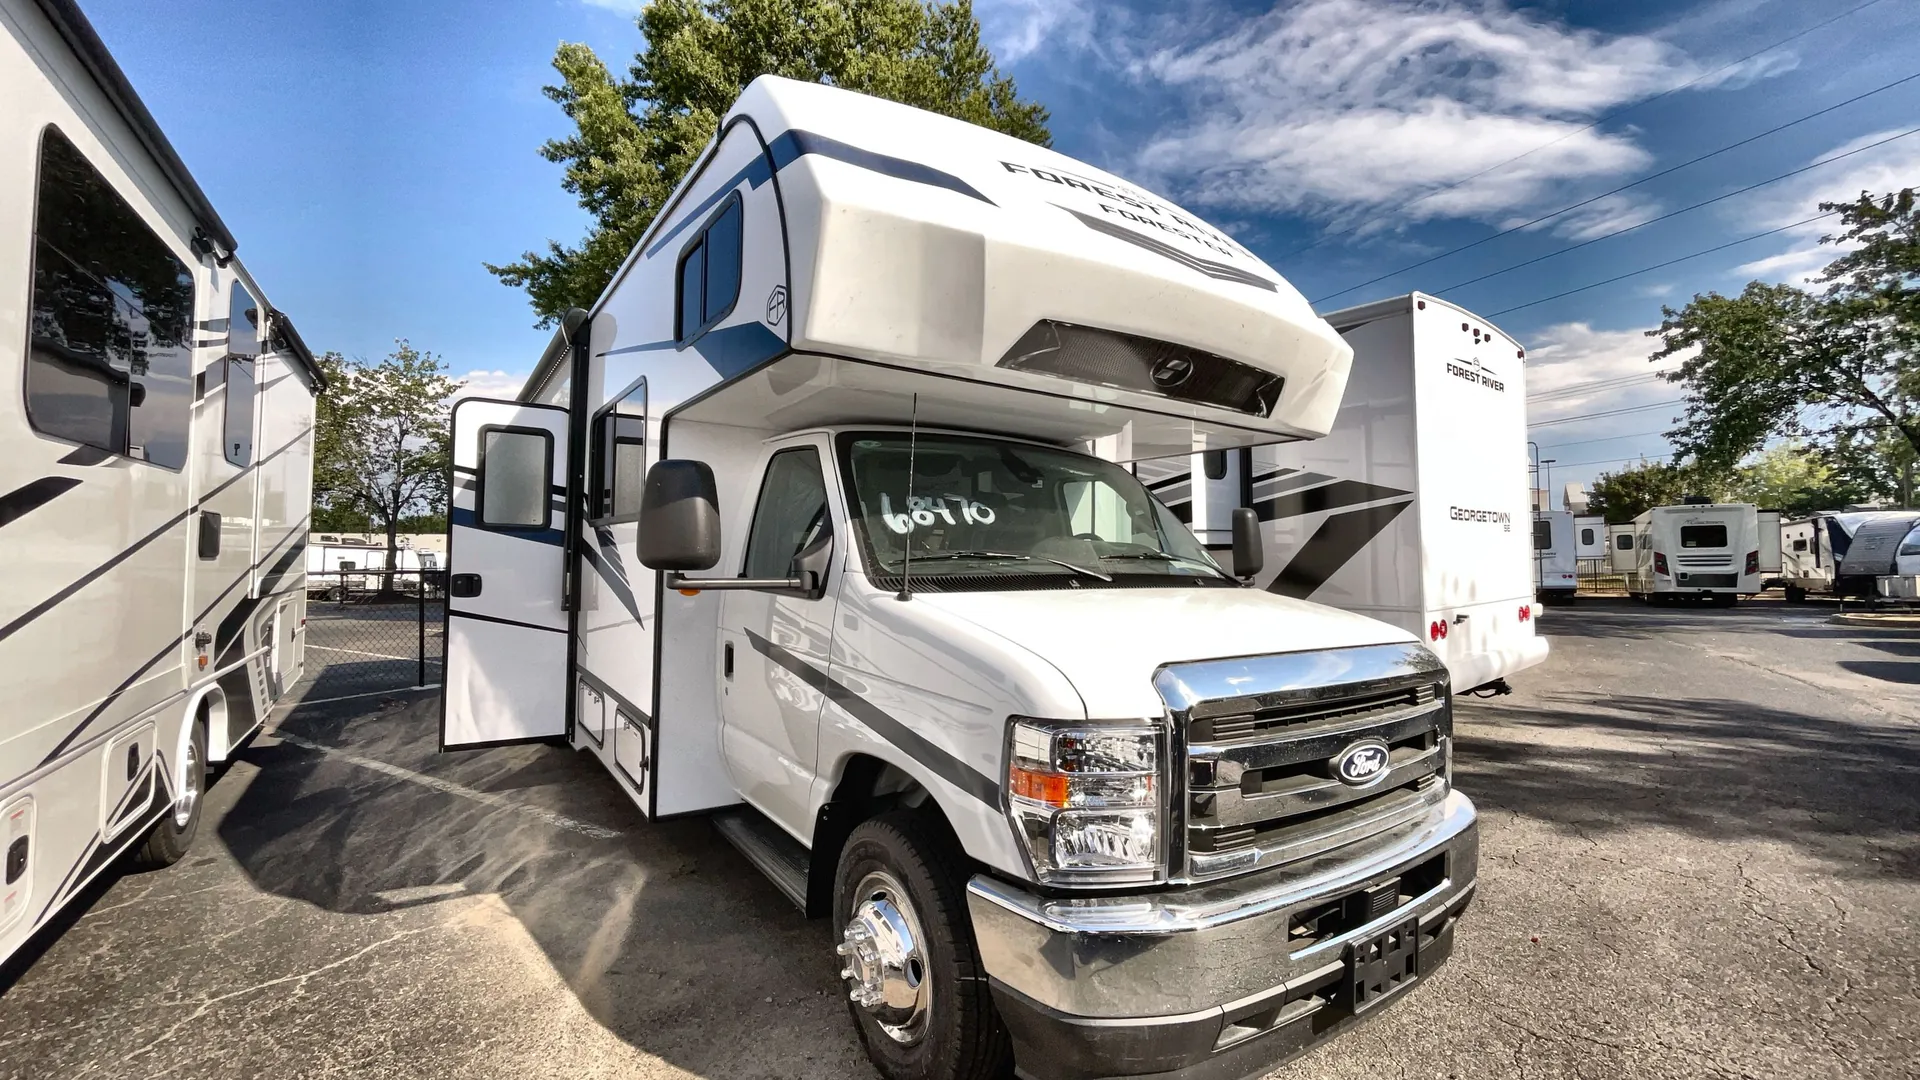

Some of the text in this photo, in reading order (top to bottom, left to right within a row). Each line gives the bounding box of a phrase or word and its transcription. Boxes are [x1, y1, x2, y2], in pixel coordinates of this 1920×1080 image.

[998, 160, 1161, 216] FOREST
[1098, 203, 1234, 258] FORESTER
[1446, 362, 1505, 393] FOREST RIVER
[1350, 749, 1382, 777] Ford
